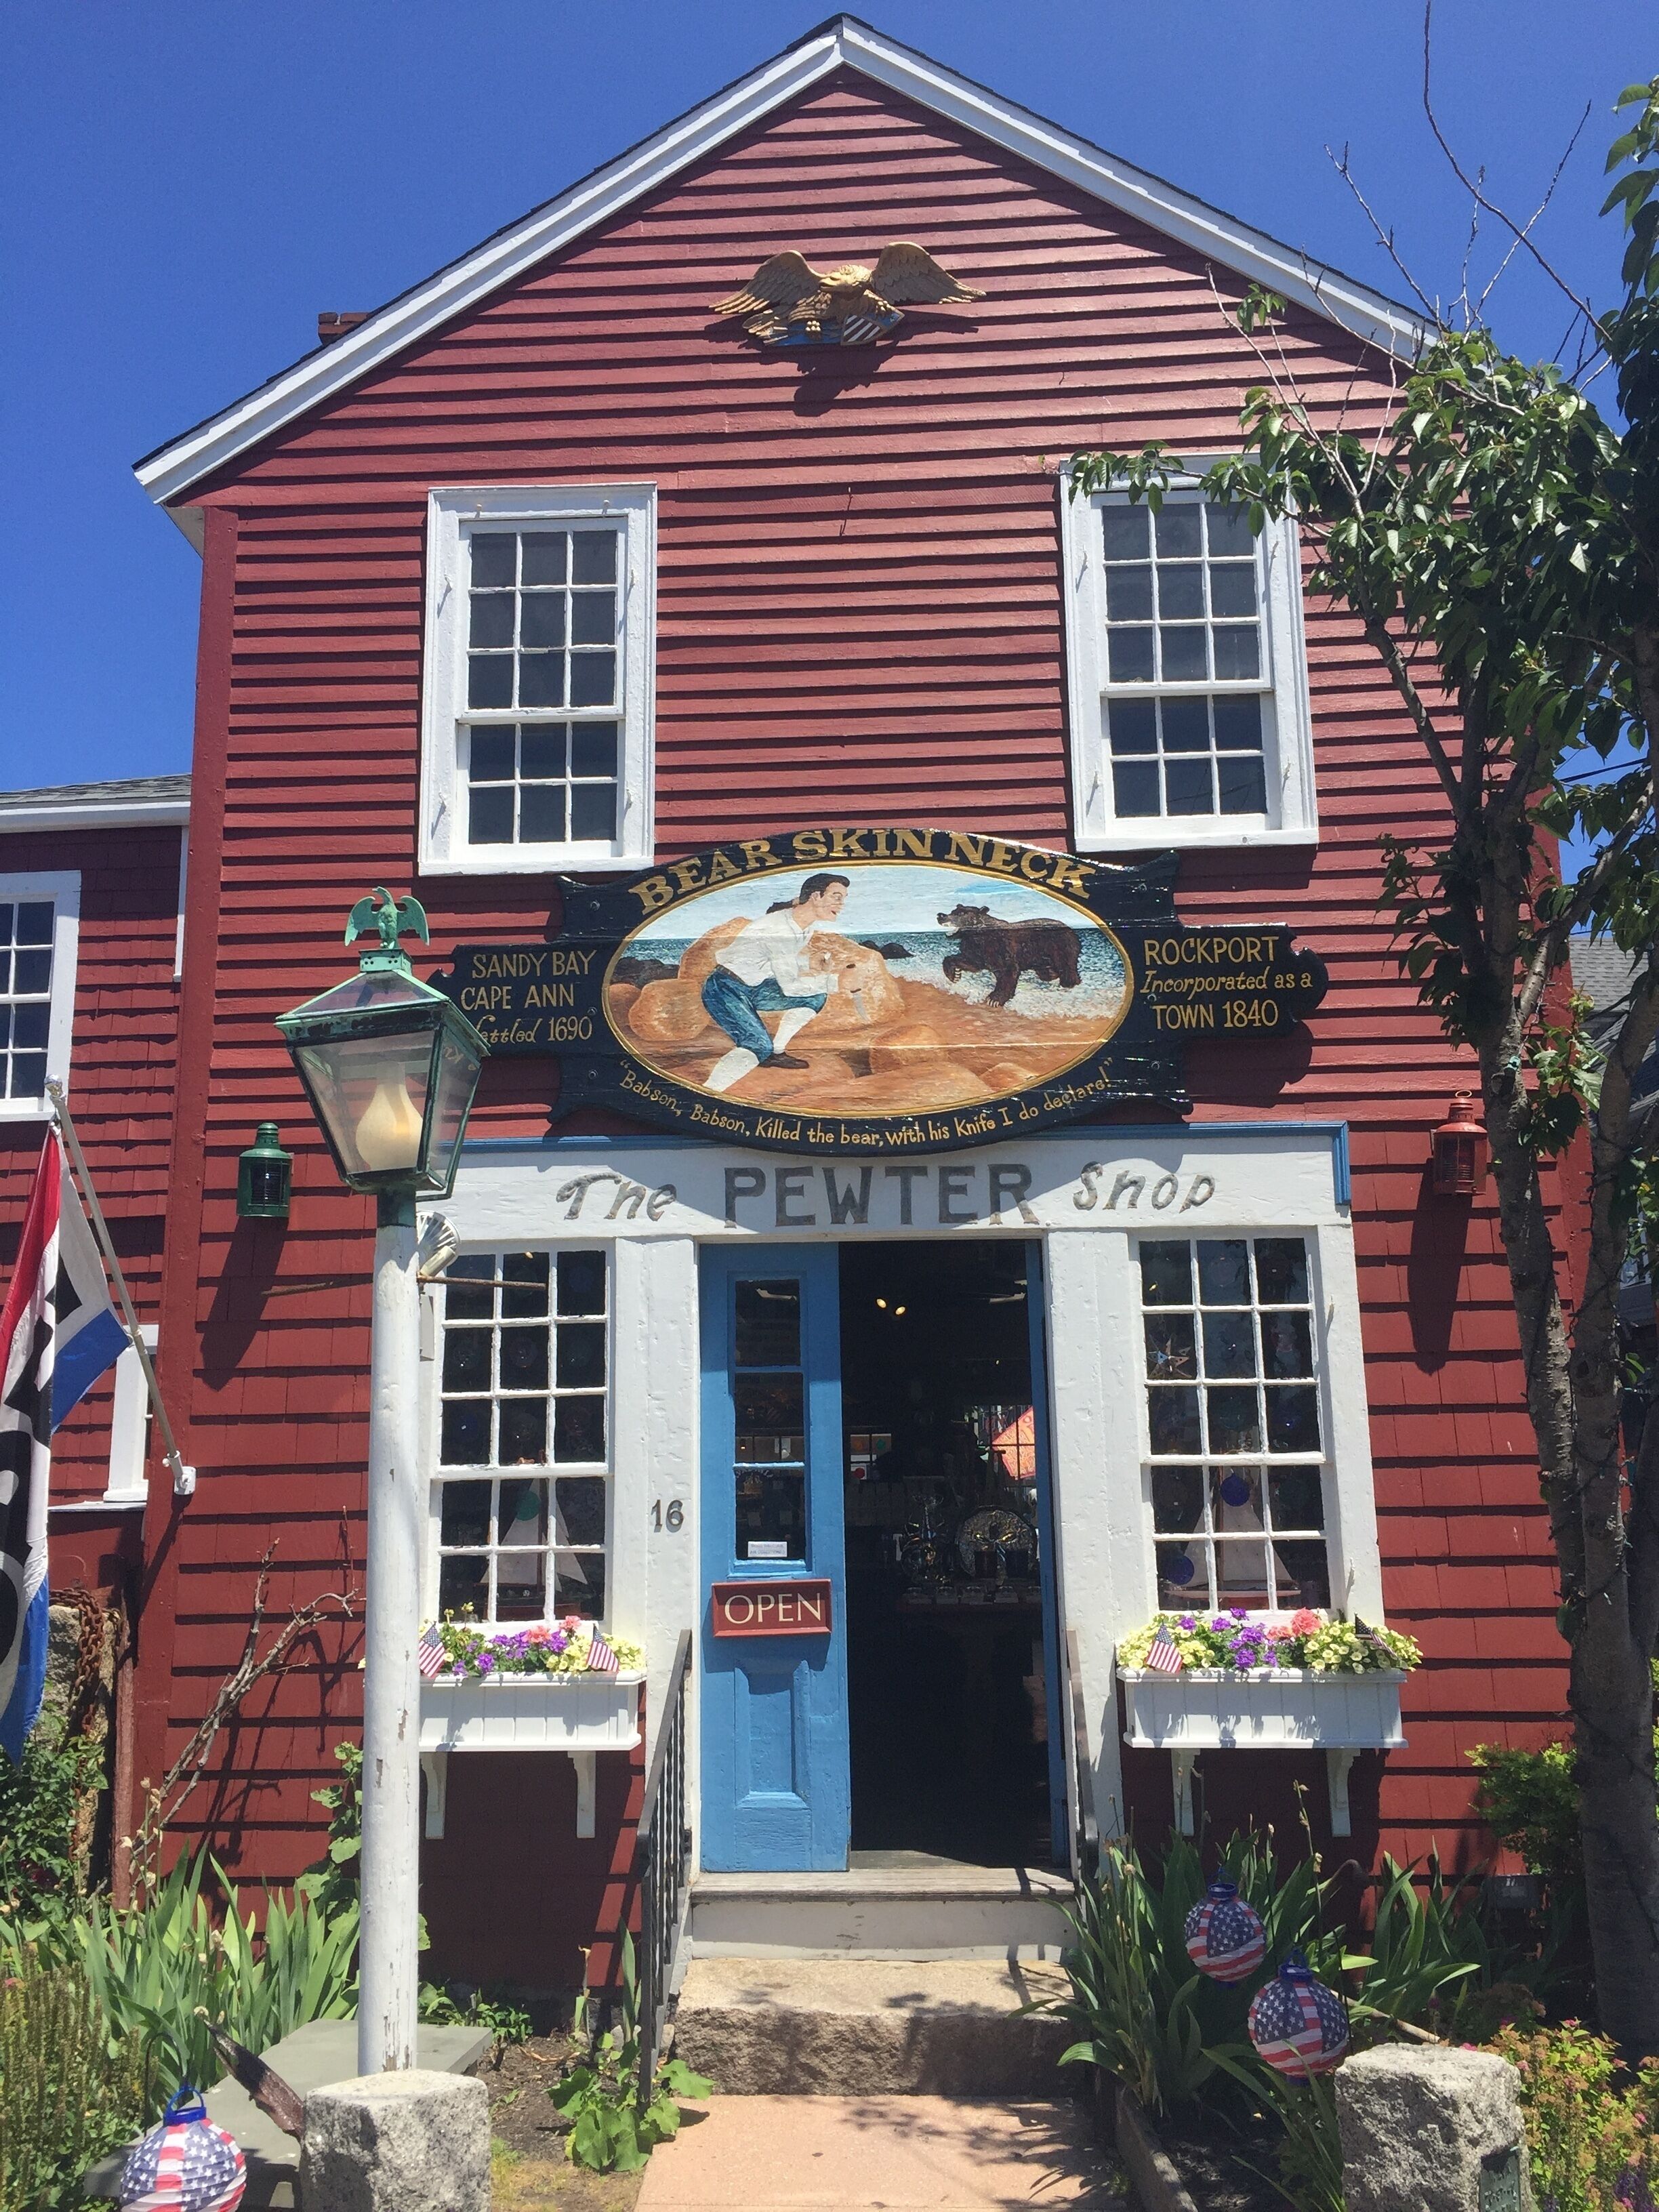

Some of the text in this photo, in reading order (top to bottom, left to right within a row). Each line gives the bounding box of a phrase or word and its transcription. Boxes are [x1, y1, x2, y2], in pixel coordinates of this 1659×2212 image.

[628, 828, 1095, 915] BEAR SKIN NECK
[472, 949, 597, 979] SANDY BAY
[1144, 936, 1279, 966] ROCKPORT
[461, 983, 575, 1010] CAPE ANN
[1140, 966, 1313, 1000] Incorporated as a
[548, 1016, 592, 1041] 1690
[1151, 999, 1279, 1029] TOWN 1840
[690, 1103, 750, 1136] Babson,
[755, 1116, 802, 1141] Killed
[806, 1122, 834, 1143] the
[840, 1124, 884, 1147] bear,
[885, 1121, 925, 1146] with
[928, 1120, 949, 1141] his
[998, 1107, 1013, 1126] I
[1019, 1101, 1039, 1120] do
[556, 1161, 1216, 1228] The PEWTER Shop
[651, 1499, 684, 1527] 16
[724, 1593, 821, 1624] OPEN
